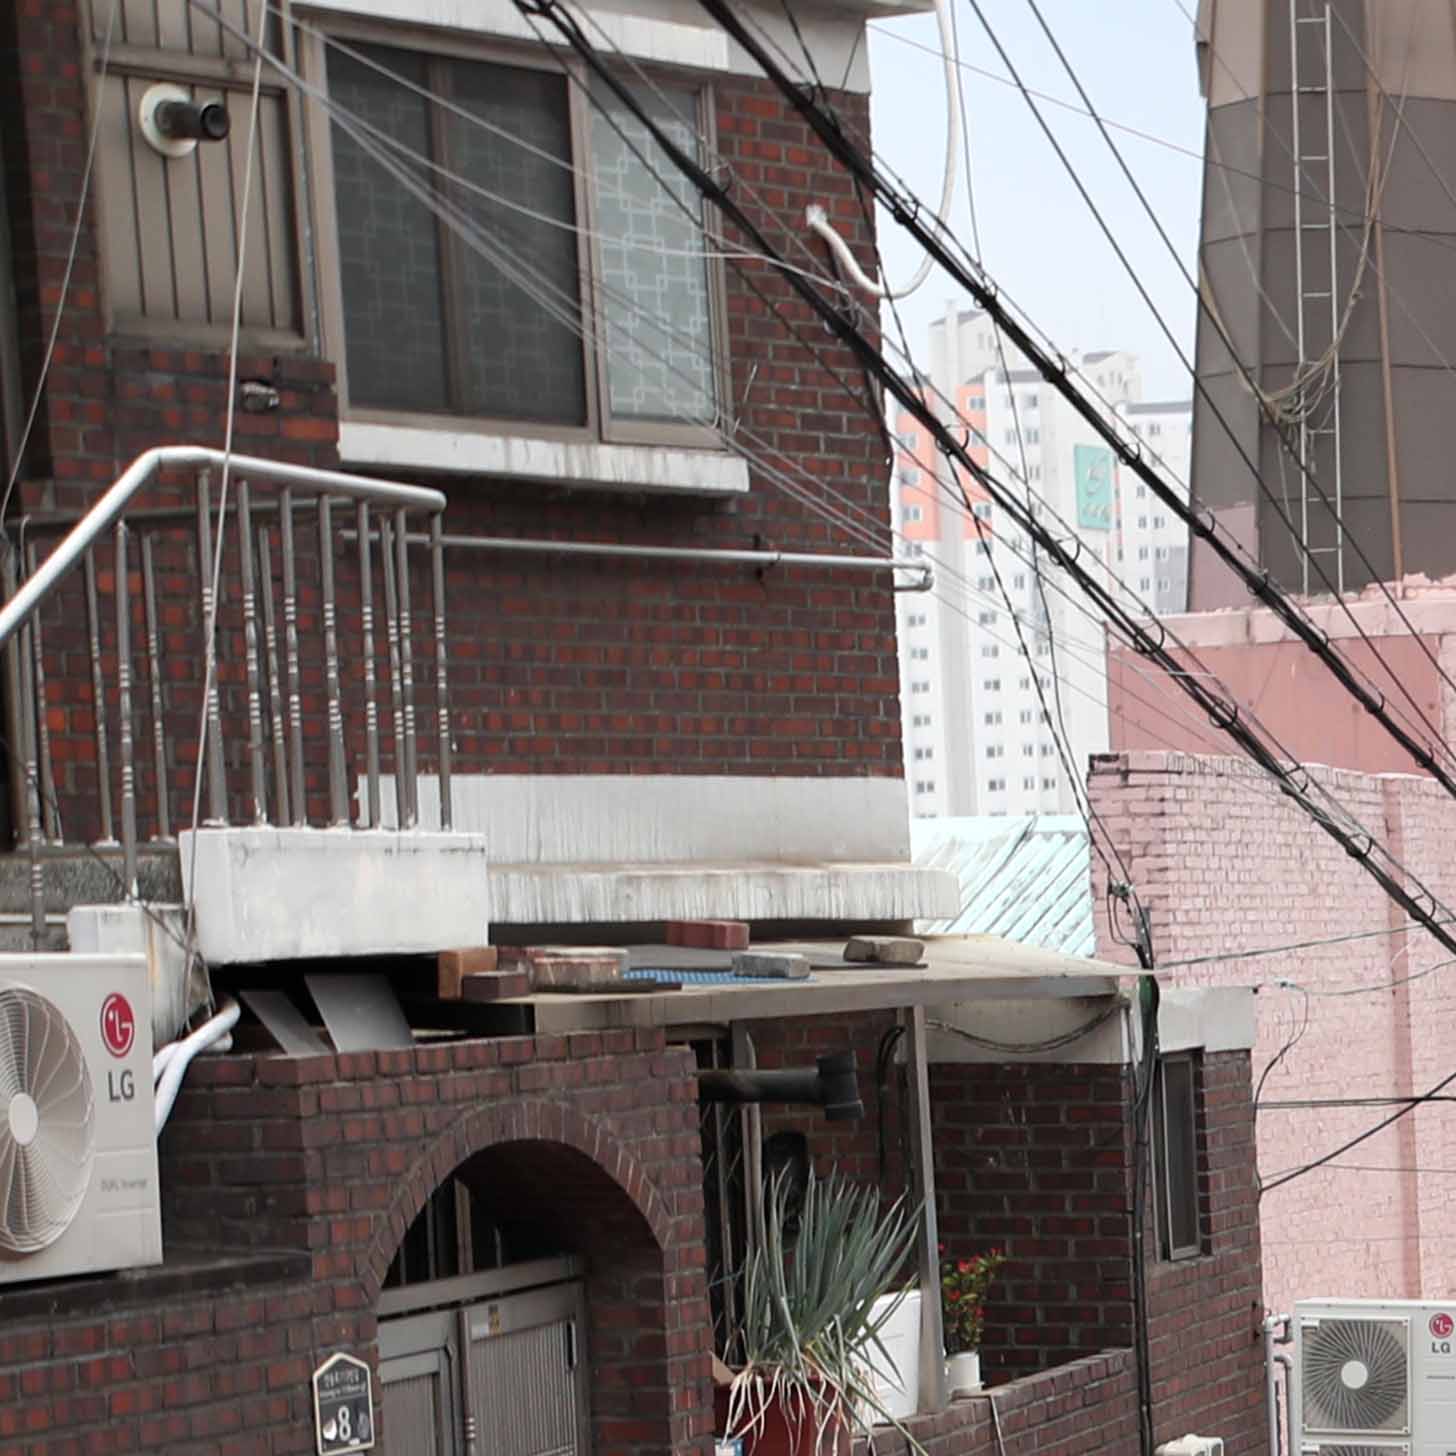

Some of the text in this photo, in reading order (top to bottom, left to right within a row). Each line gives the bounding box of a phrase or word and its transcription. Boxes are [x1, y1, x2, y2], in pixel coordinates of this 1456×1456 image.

[108, 1070, 134, 1102] LG
[1432, 1342, 1451, 1353] LG
[338, 1405, 351, 1441] 8
